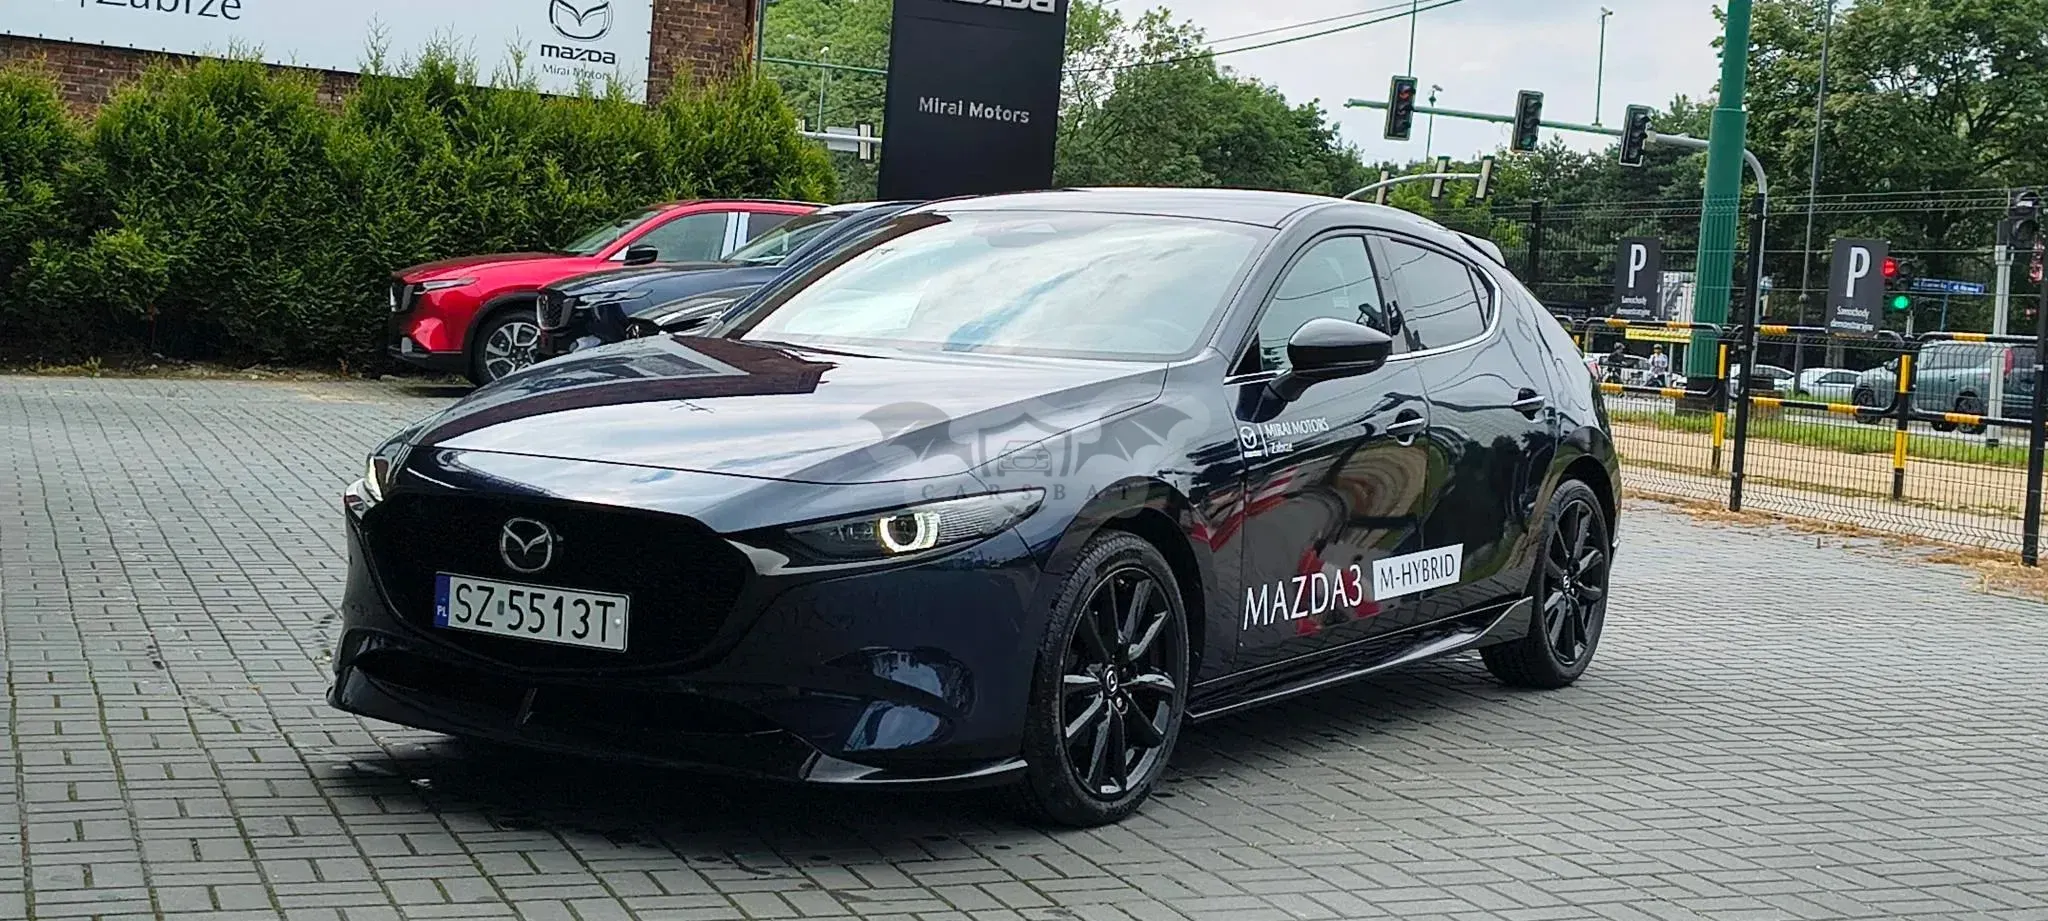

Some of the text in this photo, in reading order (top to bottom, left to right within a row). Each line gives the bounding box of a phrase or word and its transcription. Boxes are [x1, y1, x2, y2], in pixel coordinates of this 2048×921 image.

[96, 0, 241, 20] rze
[540, 44, 616, 64] mazda
[542, 63, 612, 80] Mirai Motor
[918, 96, 1030, 123] Mirai Motors
[1628, 244, 1647, 288] P
[1846, 246, 1871, 298] P
[1243, 553, 1454, 630] MAZDA3 M-HYBRID
[436, 605, 448, 617] PL
[455, 584, 616, 642] SZ 5513T
